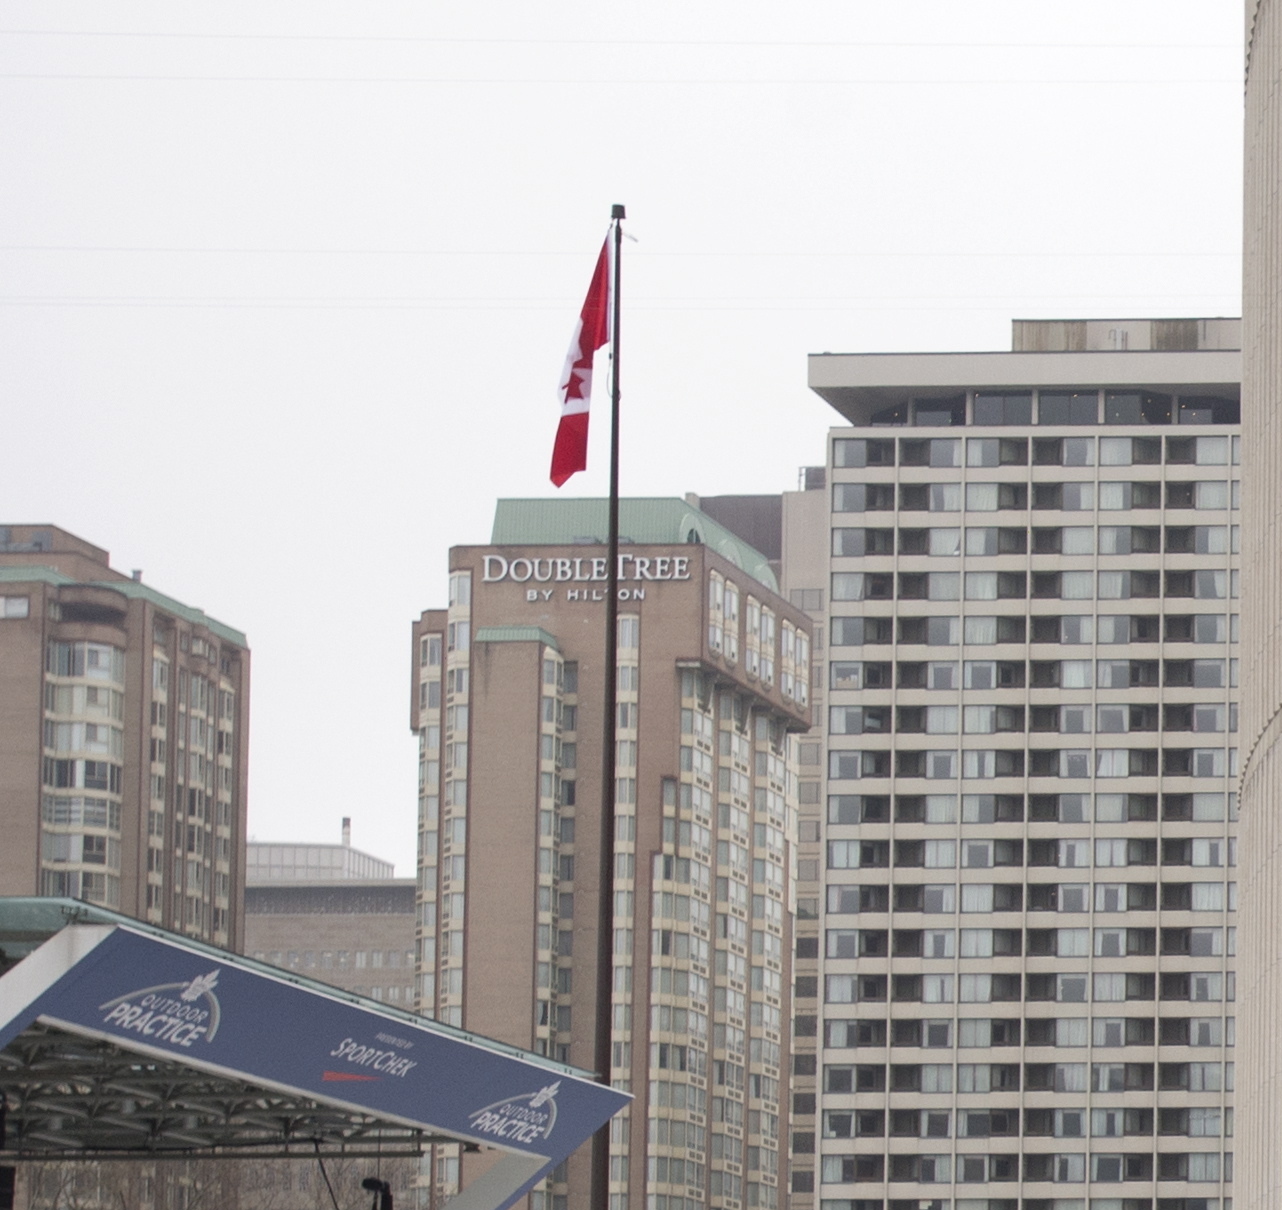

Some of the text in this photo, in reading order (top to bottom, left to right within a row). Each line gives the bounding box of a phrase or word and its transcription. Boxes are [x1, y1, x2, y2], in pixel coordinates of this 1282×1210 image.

[482, 555, 690, 582] DOUBLETREE
[526, 588, 646, 601] BY HILON
[141, 994, 208, 1023] OUTDOOR
[103, 1001, 207, 1047] PRACTICE
[330, 1037, 418, 1077] SPORTCHEK
[470, 1111, 545, 1144] PRACTICE
[500, 1104, 548, 1124] OUTDOOR
